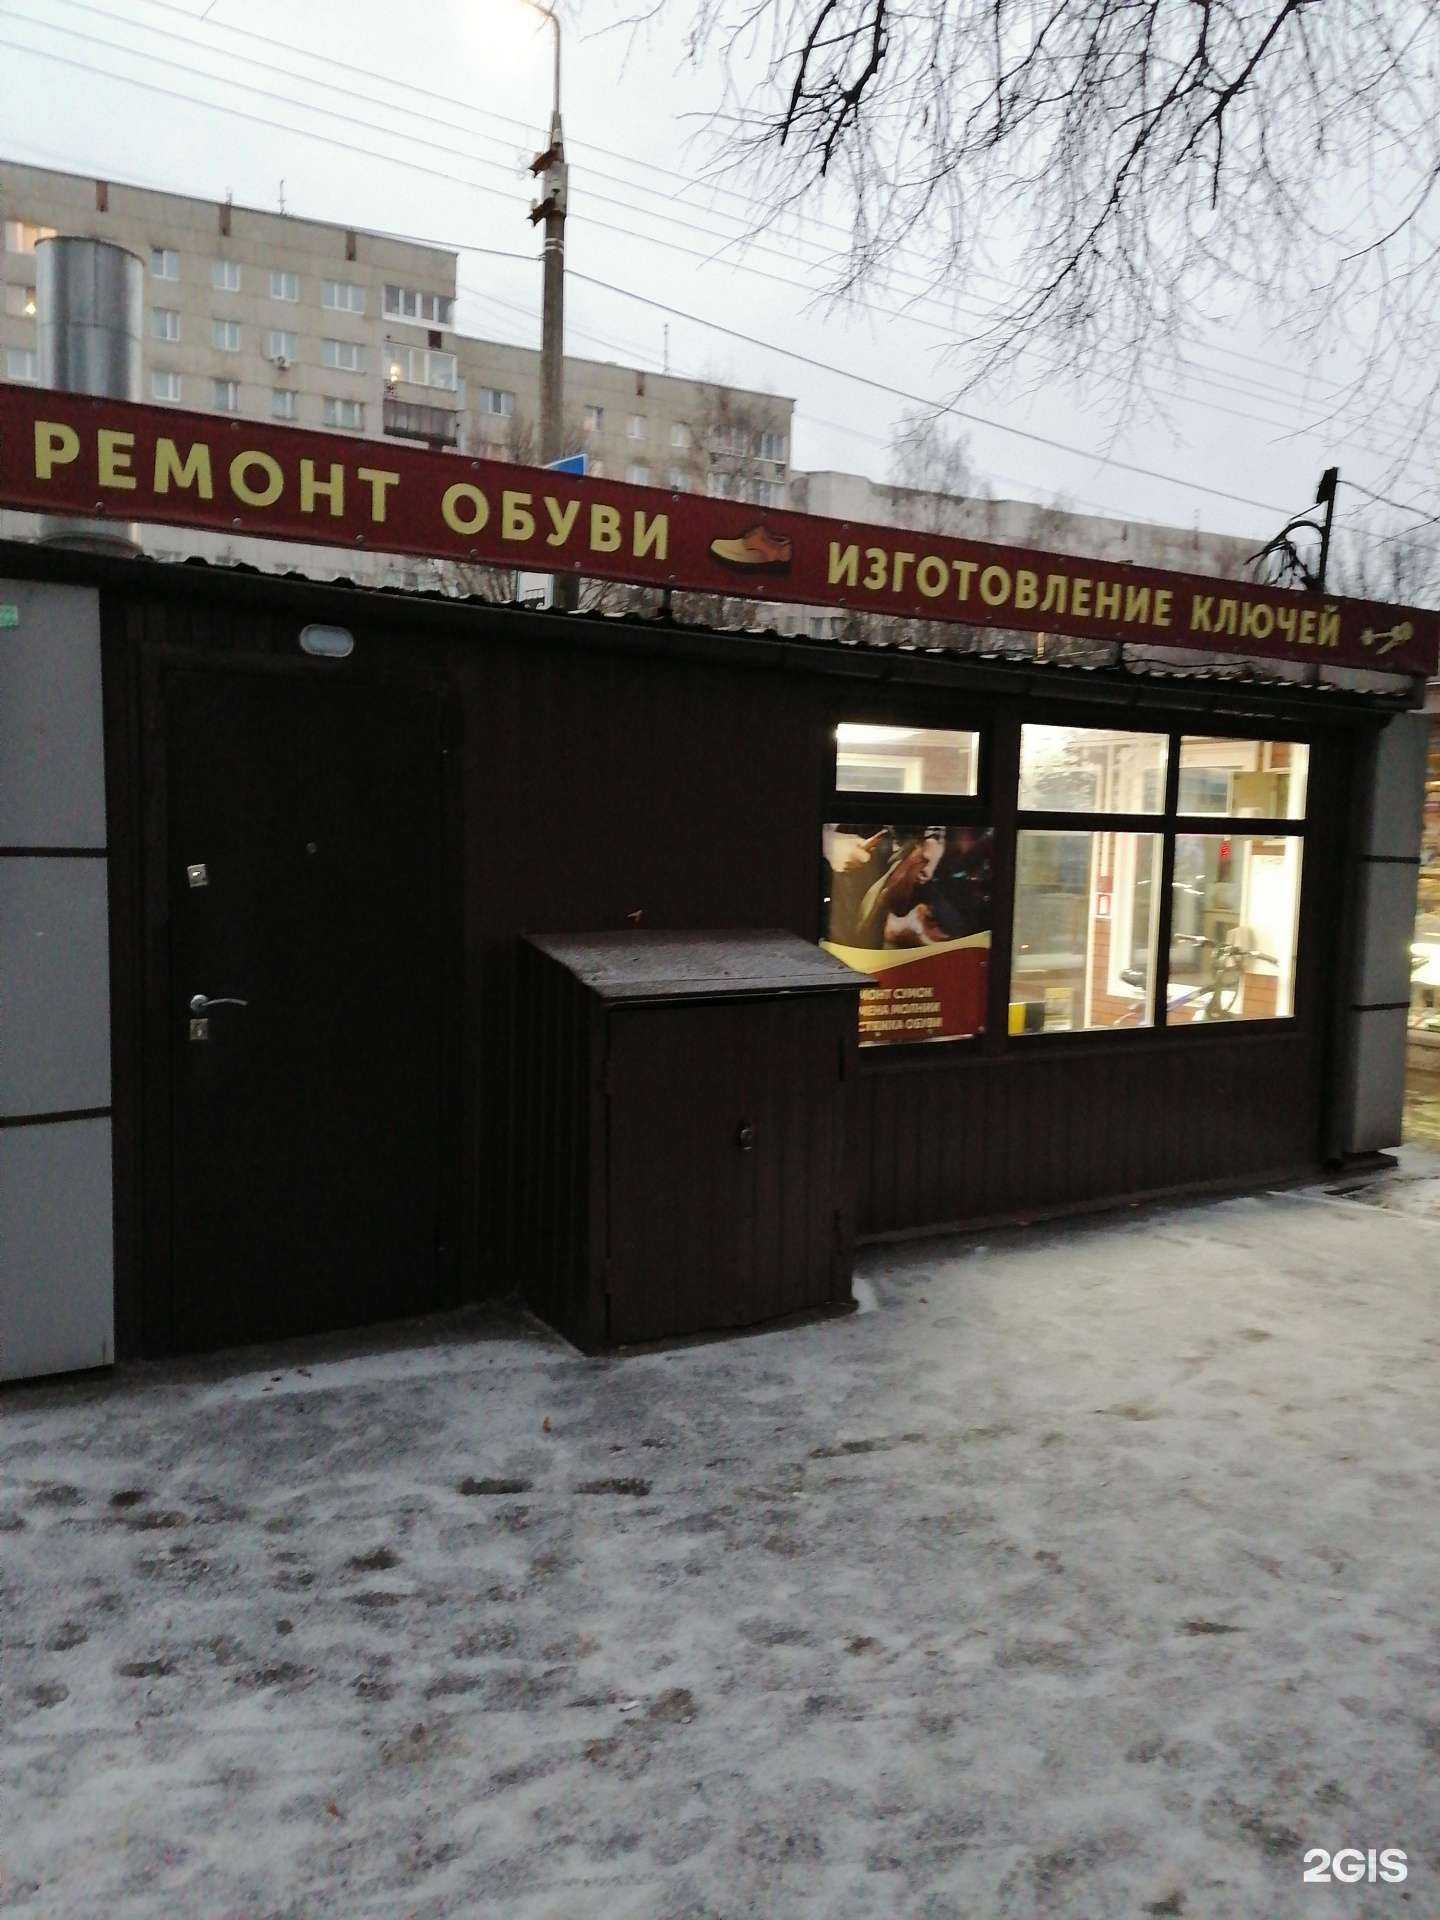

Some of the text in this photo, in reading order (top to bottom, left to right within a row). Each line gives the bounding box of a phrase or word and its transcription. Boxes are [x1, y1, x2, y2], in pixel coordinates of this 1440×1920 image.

[34, 421, 1343, 648] РЕМОНТ ОБУВИ ИЗГОТОВЛЕНИЕ КЛЮЧЕЙ
